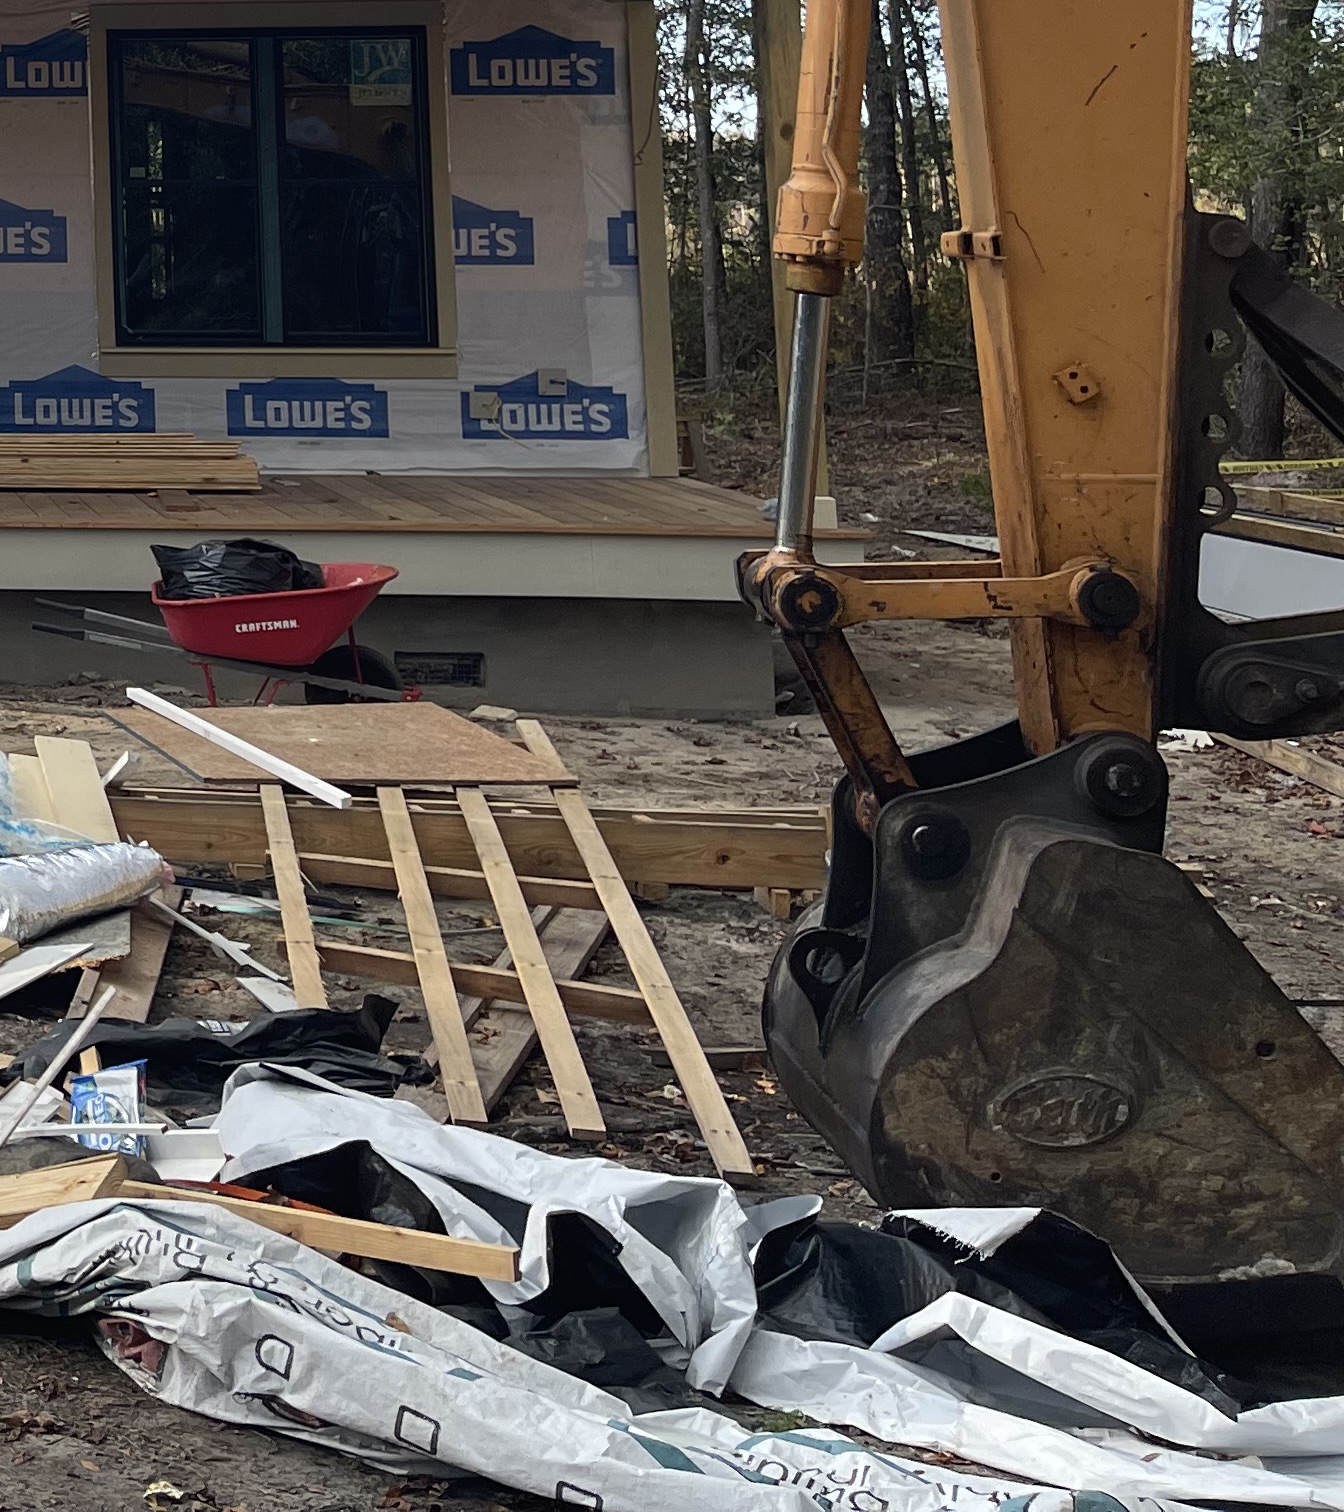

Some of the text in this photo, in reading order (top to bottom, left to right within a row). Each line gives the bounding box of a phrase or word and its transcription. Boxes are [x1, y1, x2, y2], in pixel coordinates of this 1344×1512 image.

[7, 55, 88, 89] LOW
[354, 42, 406, 77] JW
[469, 52, 598, 87] LOWE'S
[14, 392, 139, 427] LOWE'S
[243, 395, 372, 430] LOWE'S
[480, 398, 612, 432] OWE'S
[235, 619, 298, 633] CRAFTSMAN
